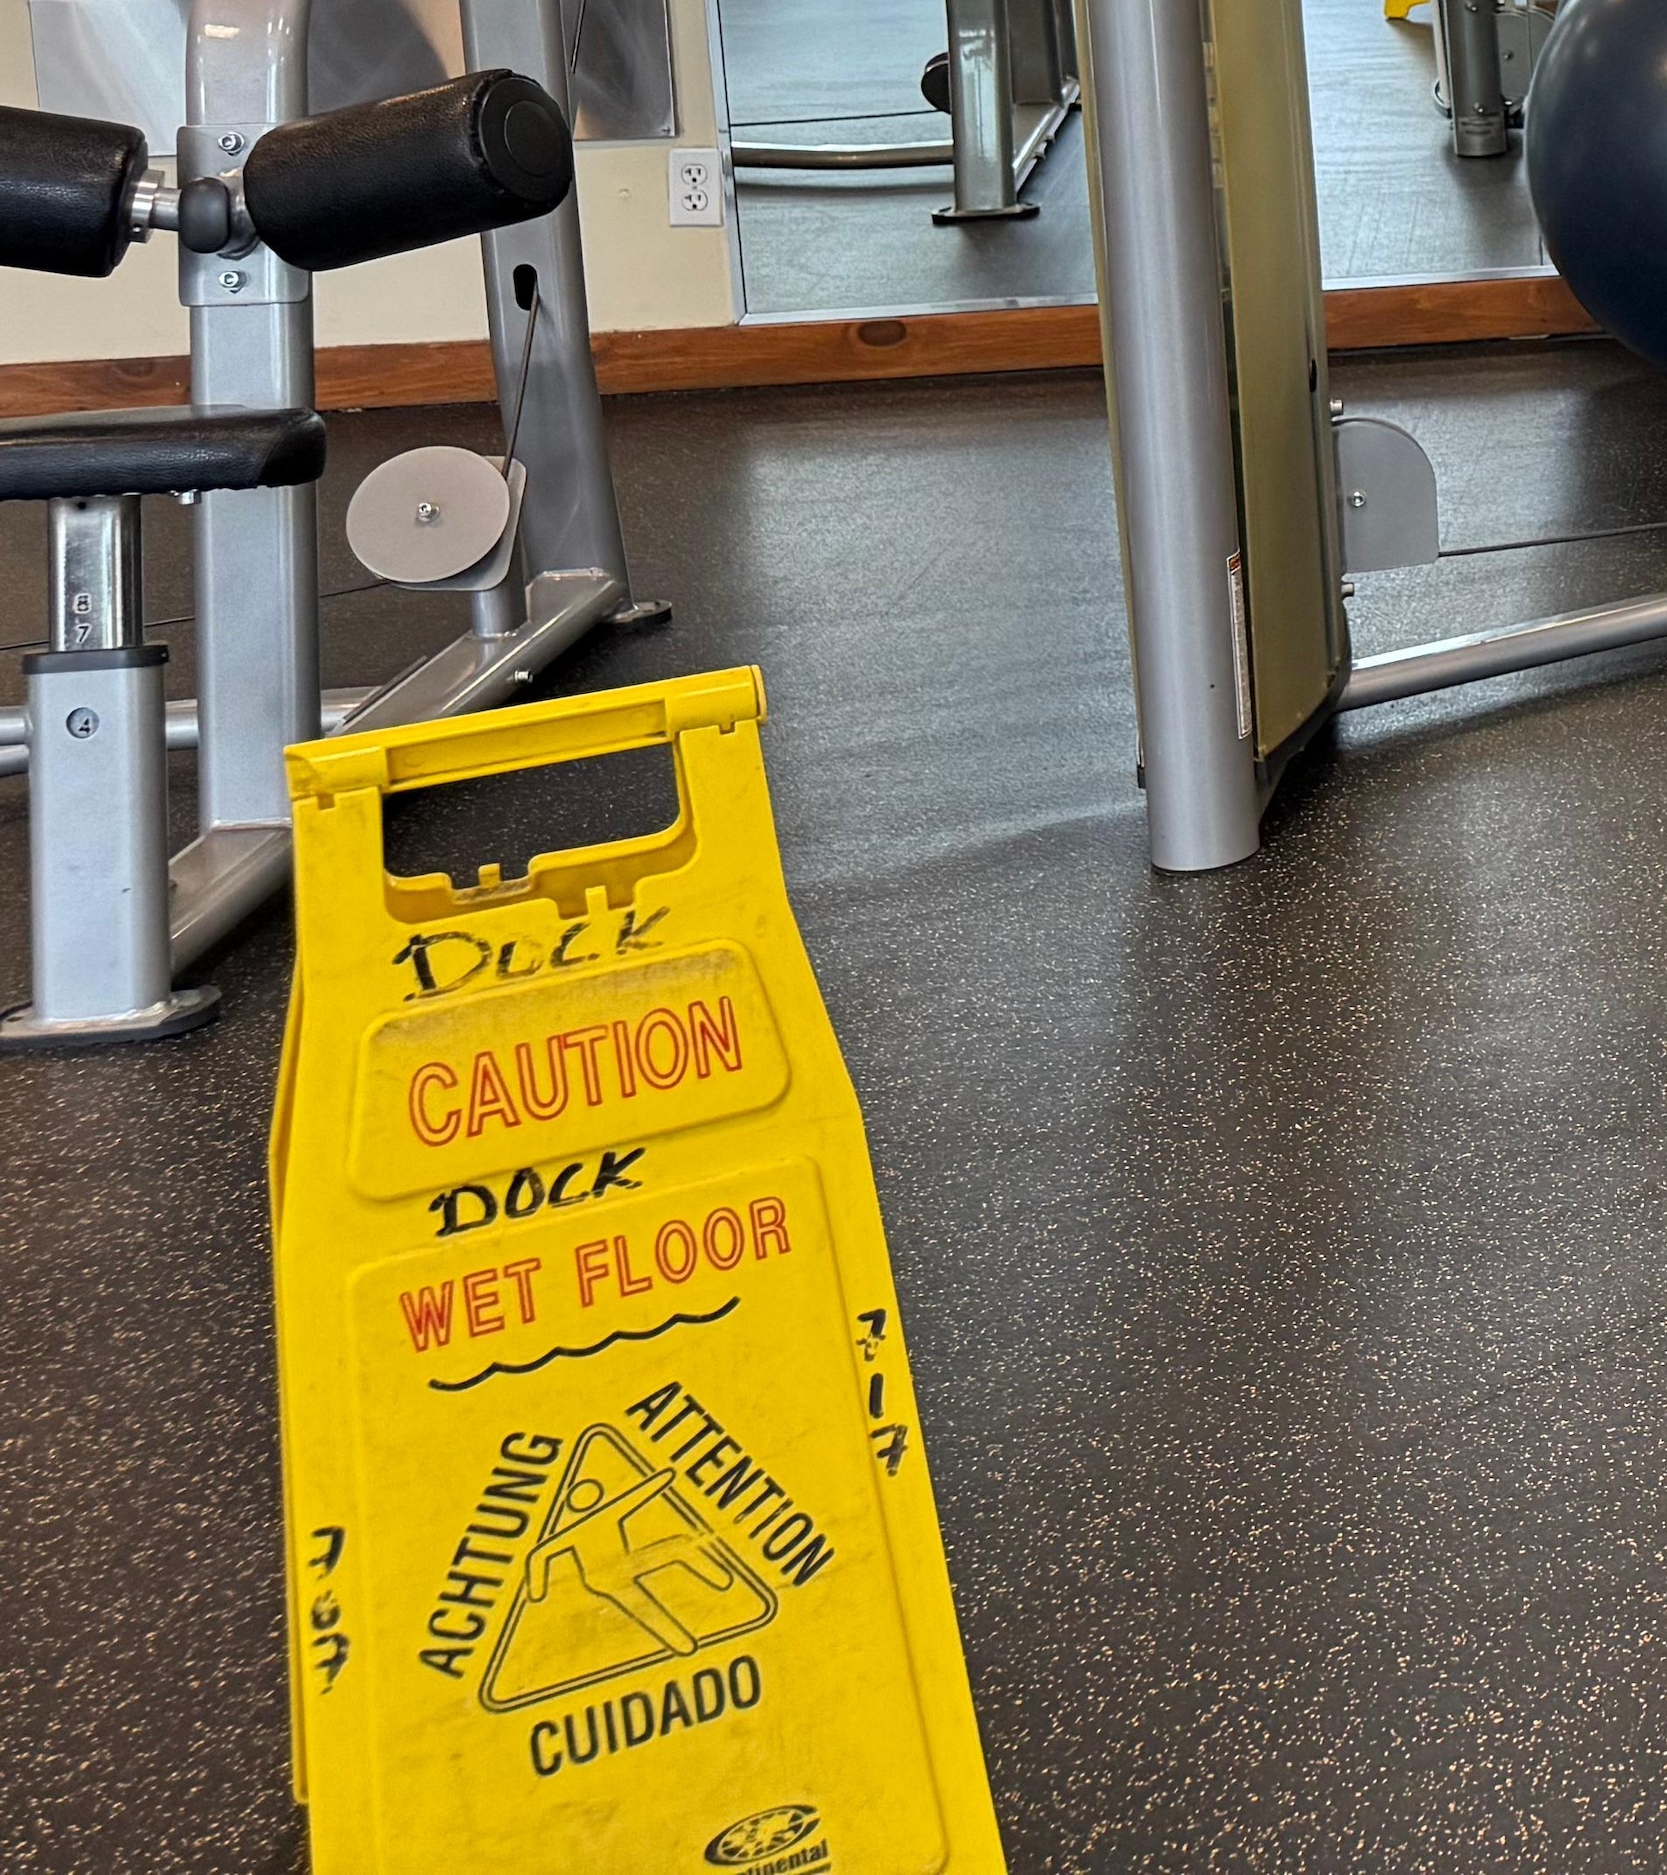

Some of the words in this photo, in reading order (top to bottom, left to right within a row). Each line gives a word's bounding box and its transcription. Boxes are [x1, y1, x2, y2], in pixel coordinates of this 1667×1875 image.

[74, 593, 91, 614] 8
[76, 623, 91, 643] 7
[409, 996, 742, 1147] CAUTION
[428, 1147, 645, 1238] DOCK
[400, 1258, 541, 1353] WET
[576, 1196, 791, 1308] FLOOR
[625, 1381, 836, 1586] ATTENTION
[417, 1431, 564, 1679] ACHTUNG
[529, 1655, 761, 1777] CUIDADO
